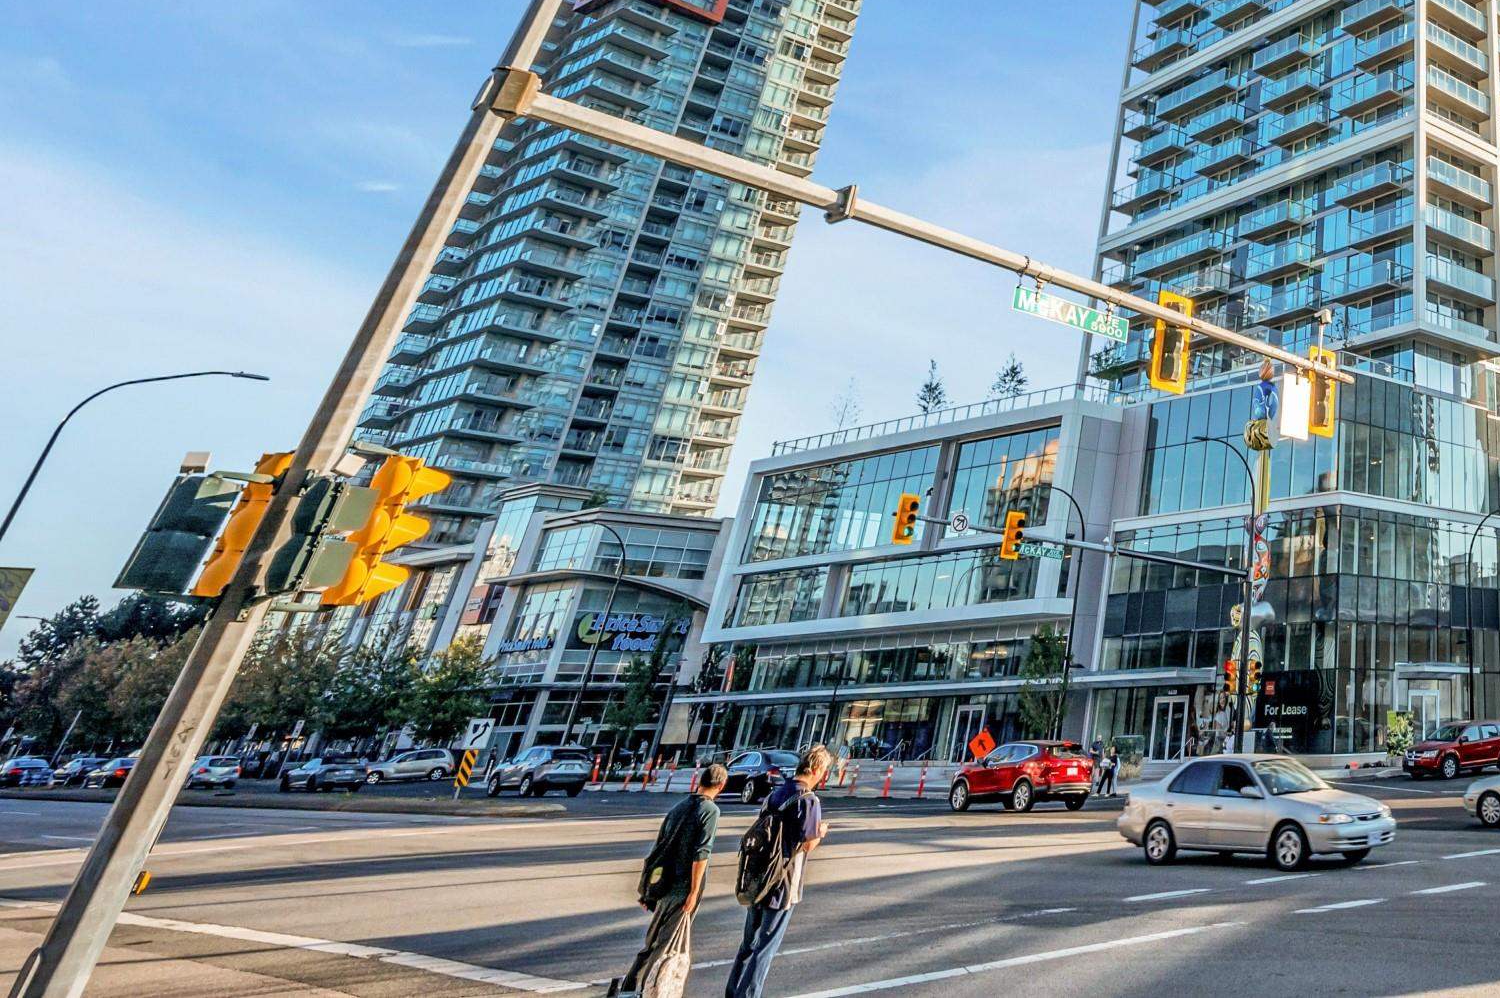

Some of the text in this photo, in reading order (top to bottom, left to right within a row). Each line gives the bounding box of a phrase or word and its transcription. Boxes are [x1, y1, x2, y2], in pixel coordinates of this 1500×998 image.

[1018, 288, 1090, 327] MKAY
[592, 613, 690, 634] PriceSmrt
[1264, 703, 1308, 715] For Lease
